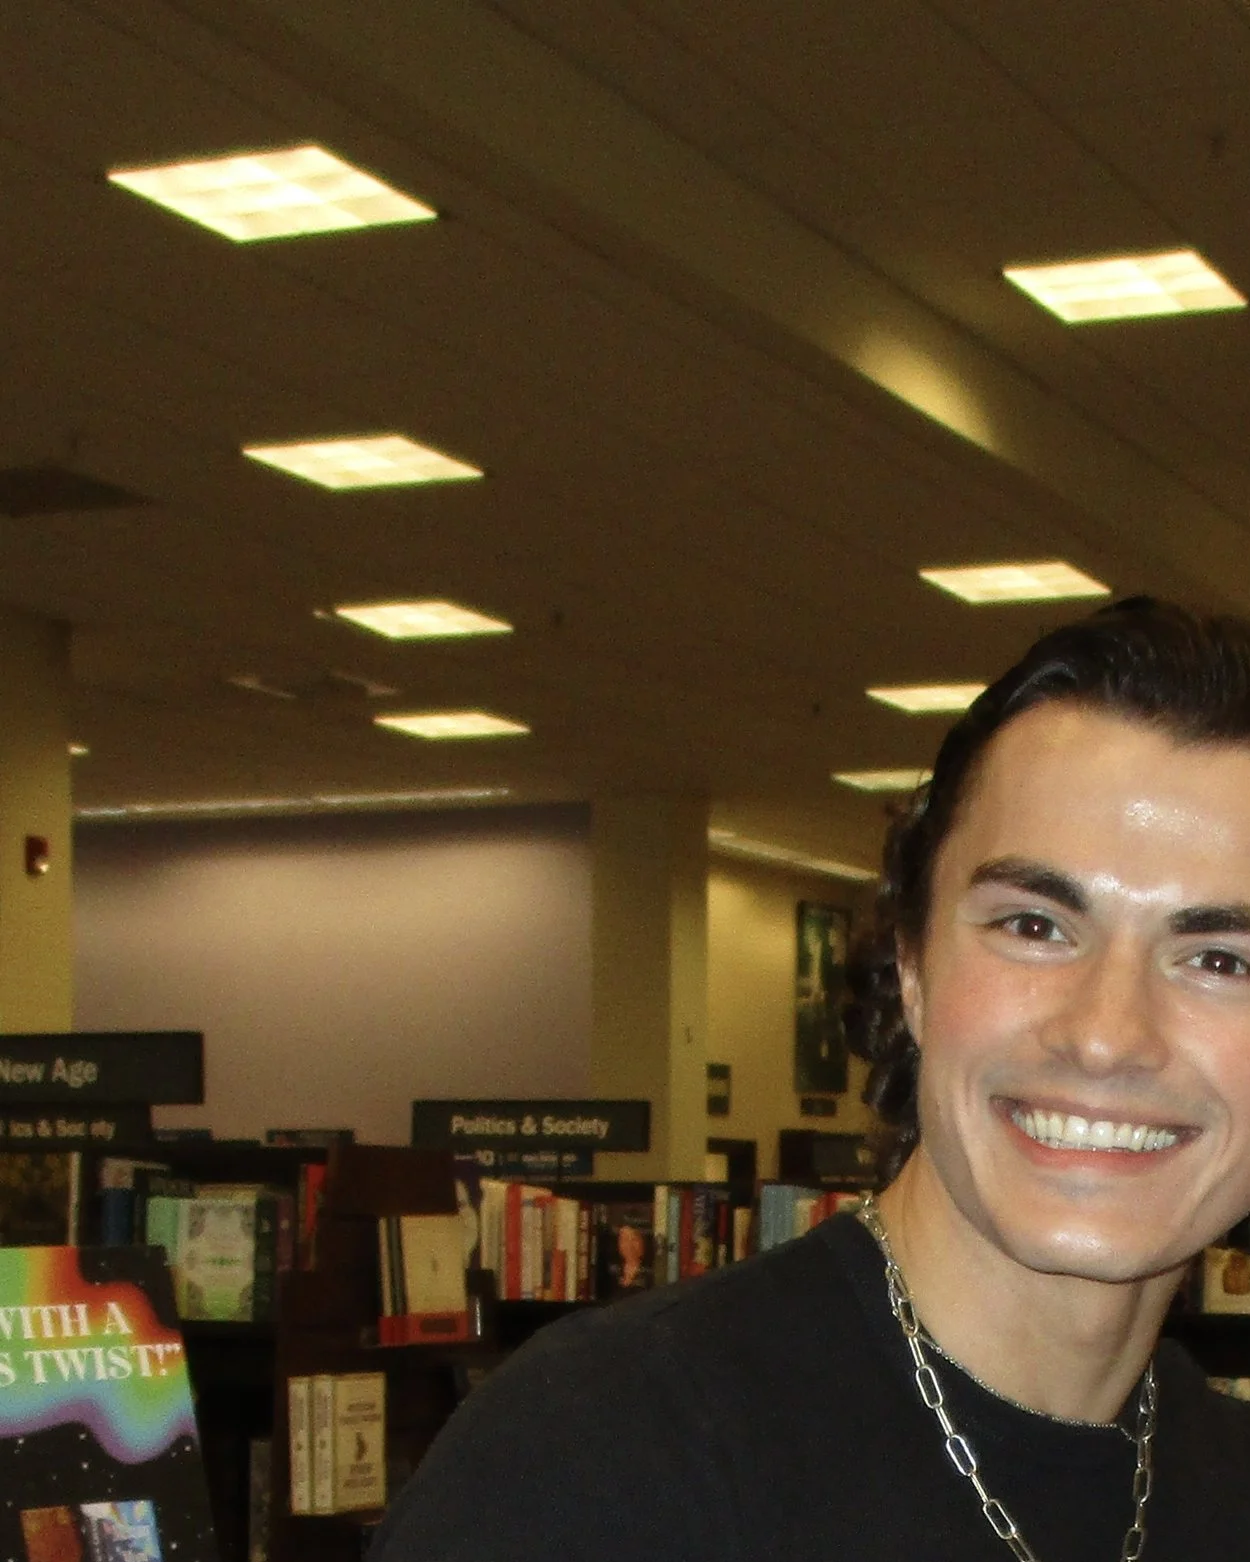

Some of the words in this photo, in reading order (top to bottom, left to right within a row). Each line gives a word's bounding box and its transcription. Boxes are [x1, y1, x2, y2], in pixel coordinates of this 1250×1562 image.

[52, 1056, 99, 1089] Age
[451, 1115, 517, 1135] Politics
[521, 1114, 538, 1136] &
[542, 1115, 609, 1140] Society
[104, 1301, 133, 1336] A
